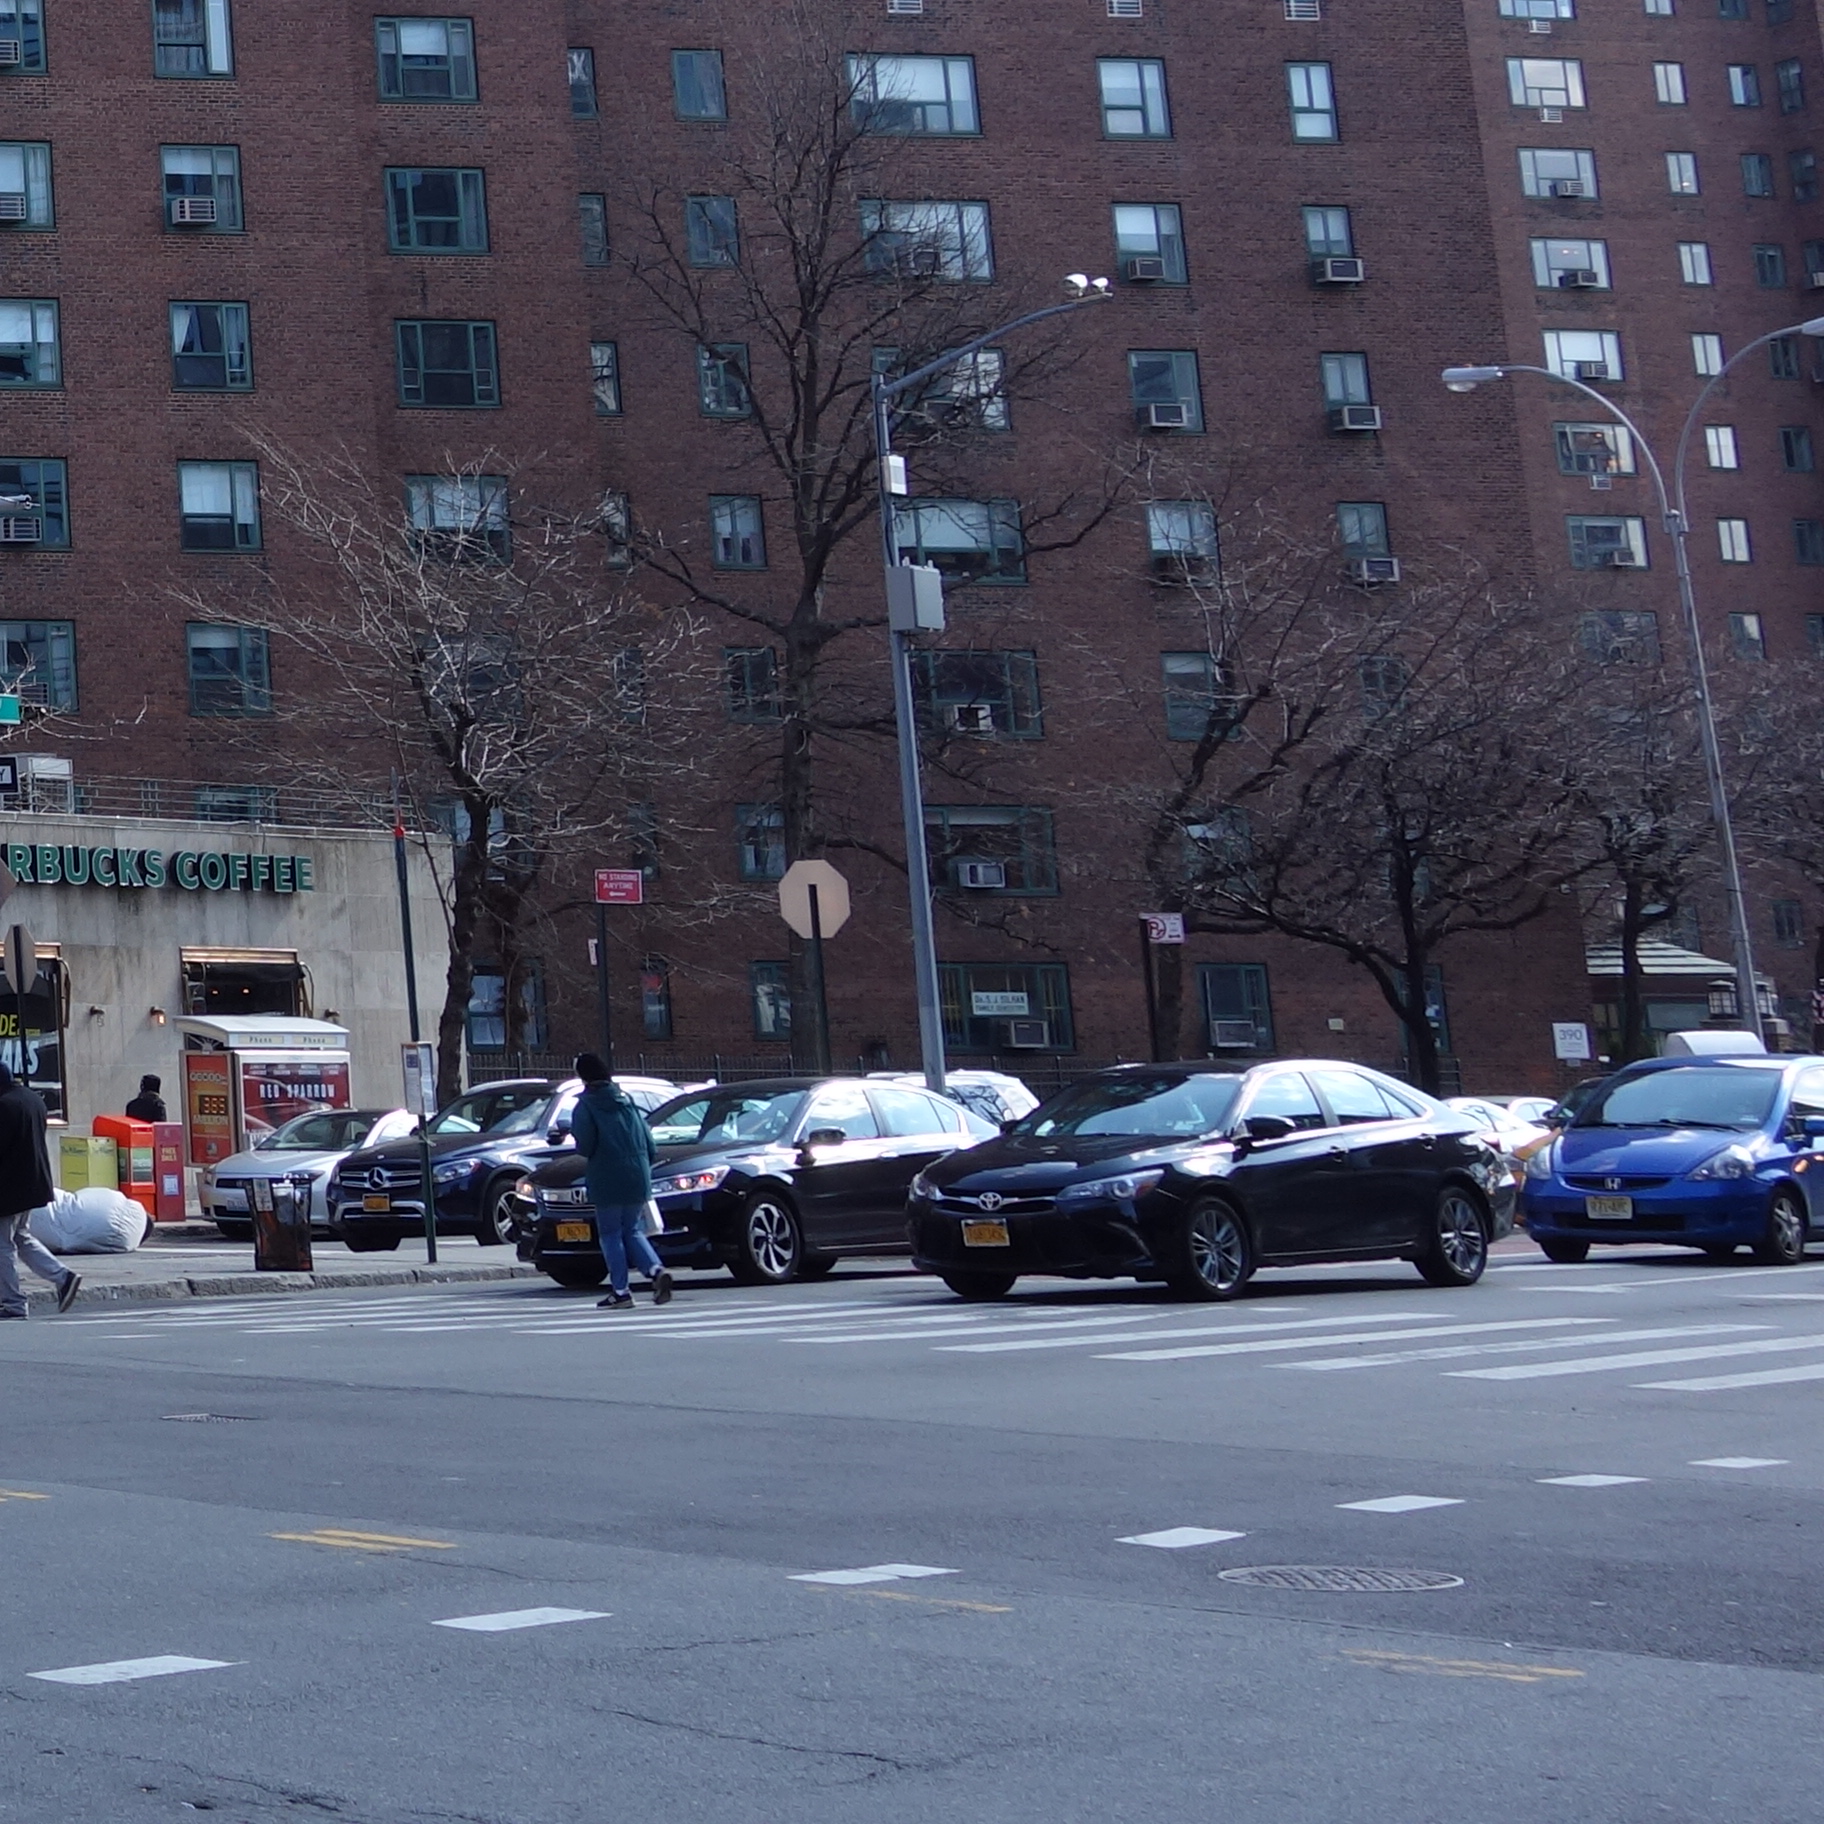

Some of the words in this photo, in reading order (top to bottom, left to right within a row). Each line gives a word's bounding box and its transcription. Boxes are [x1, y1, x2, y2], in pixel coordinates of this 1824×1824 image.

[176, 850, 314, 893] COFFEE
[609, 873, 638, 881] STANDING
[603, 882, 634, 890] ANYTIME
[1558, 1029, 1583, 1041] 390
[259, 1083, 280, 1098] RED
[287, 1083, 335, 1098] SPARROW
